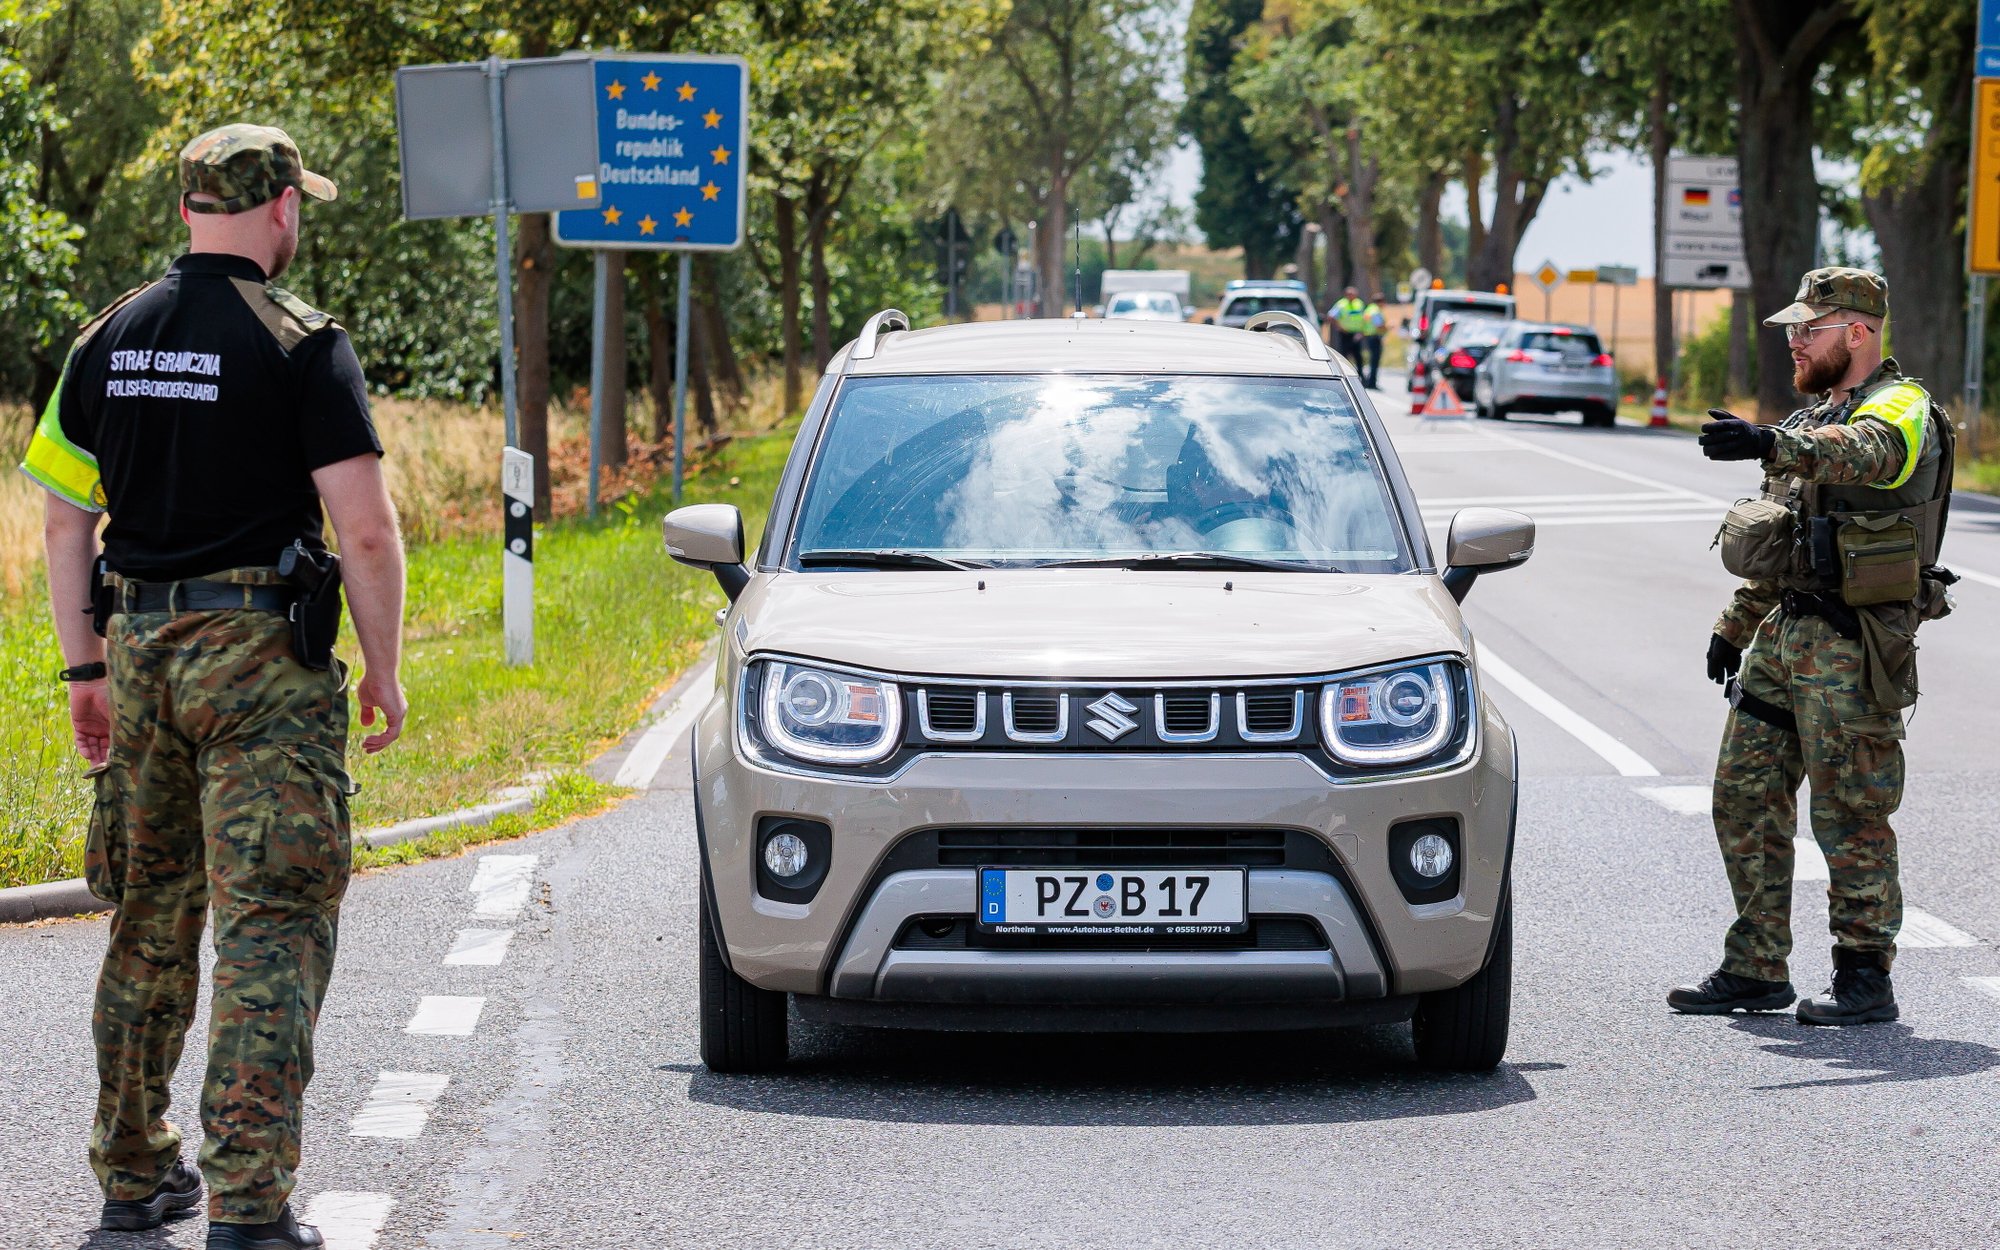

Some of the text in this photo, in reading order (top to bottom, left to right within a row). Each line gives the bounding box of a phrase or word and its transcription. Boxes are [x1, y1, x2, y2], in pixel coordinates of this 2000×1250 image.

[616, 108, 684, 131] Bundes-
[616, 137, 684, 162] republik
[600, 163, 700, 186] Deutschland
[180, 382, 219, 402] GUARD
[1035, 876, 1210, 916] PZ B 17
[989, 903, 999, 914] D
[995, 925, 1231, 934] Northeim www.Autohaus-Bethel.de 05551/9771-0
